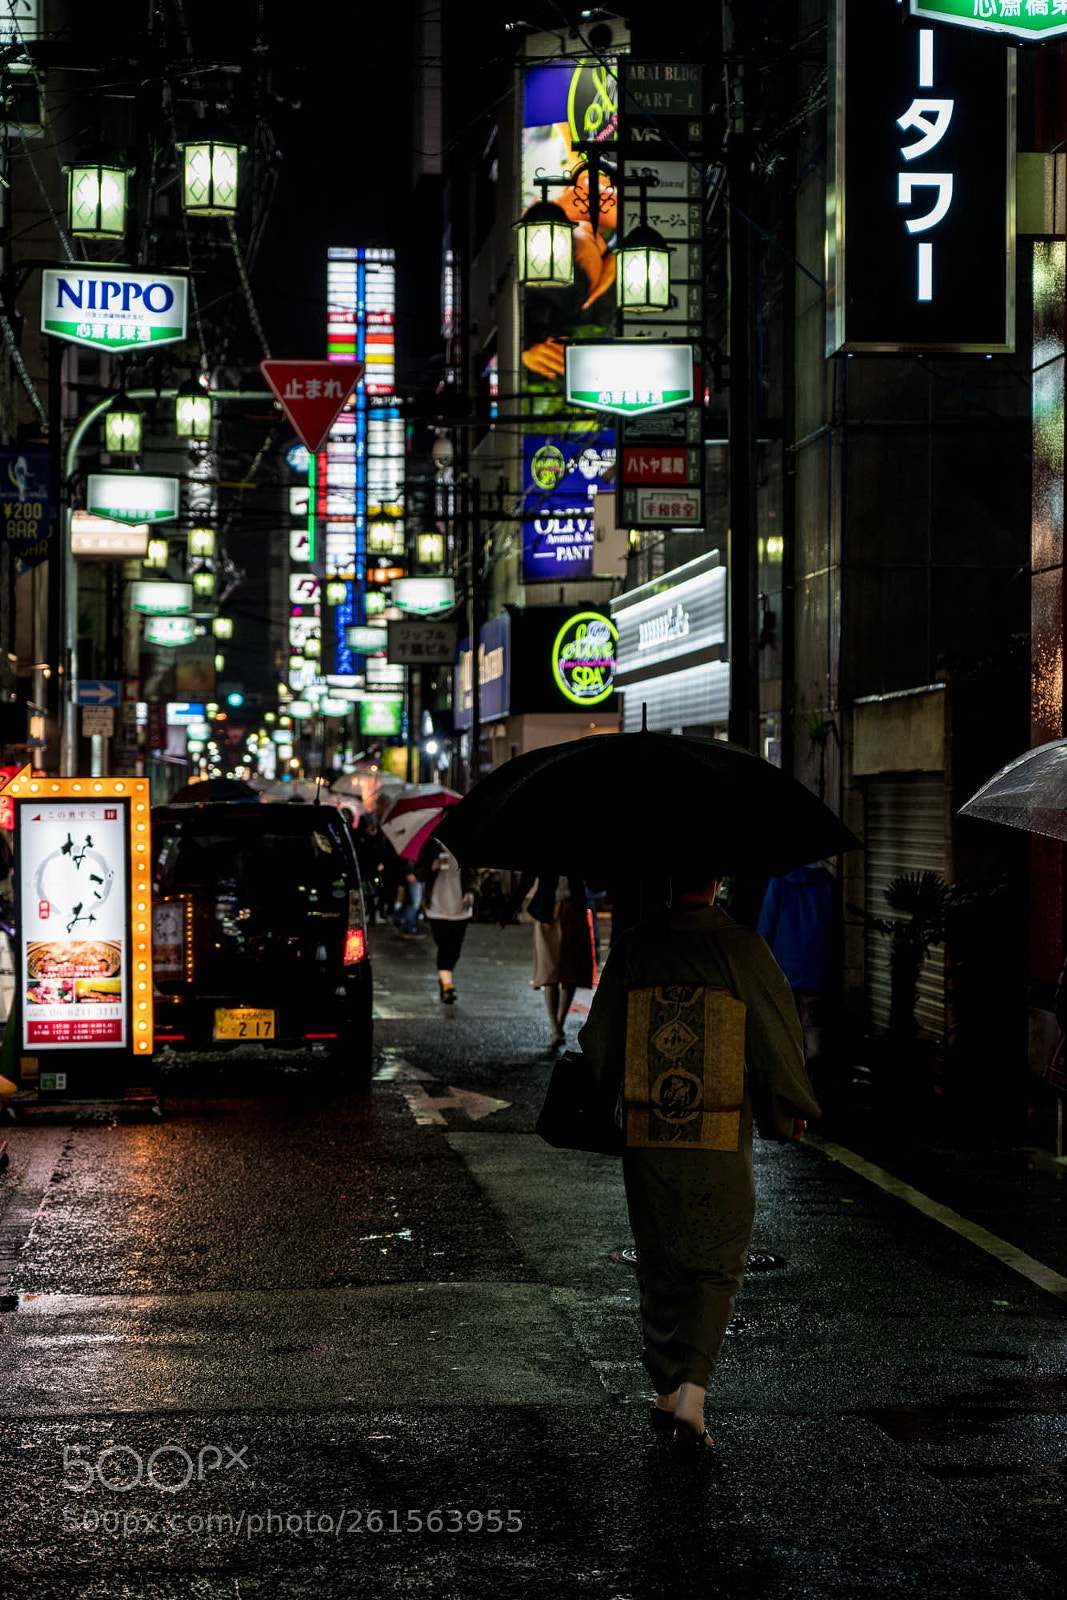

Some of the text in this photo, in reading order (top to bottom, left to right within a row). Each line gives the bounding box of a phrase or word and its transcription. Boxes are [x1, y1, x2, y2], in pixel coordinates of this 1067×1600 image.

[896, 29, 954, 301] ータワー
[627, 212, 686, 227] アマージュ
[56, 278, 174, 313] NIPPO
[283, 378, 344, 399] 止まれ
[3, 502, 42, 519] ¥200
[534, 507, 594, 534] OLIV
[6, 520, 38, 539] BAR
[571, 666, 606, 691] SPA
